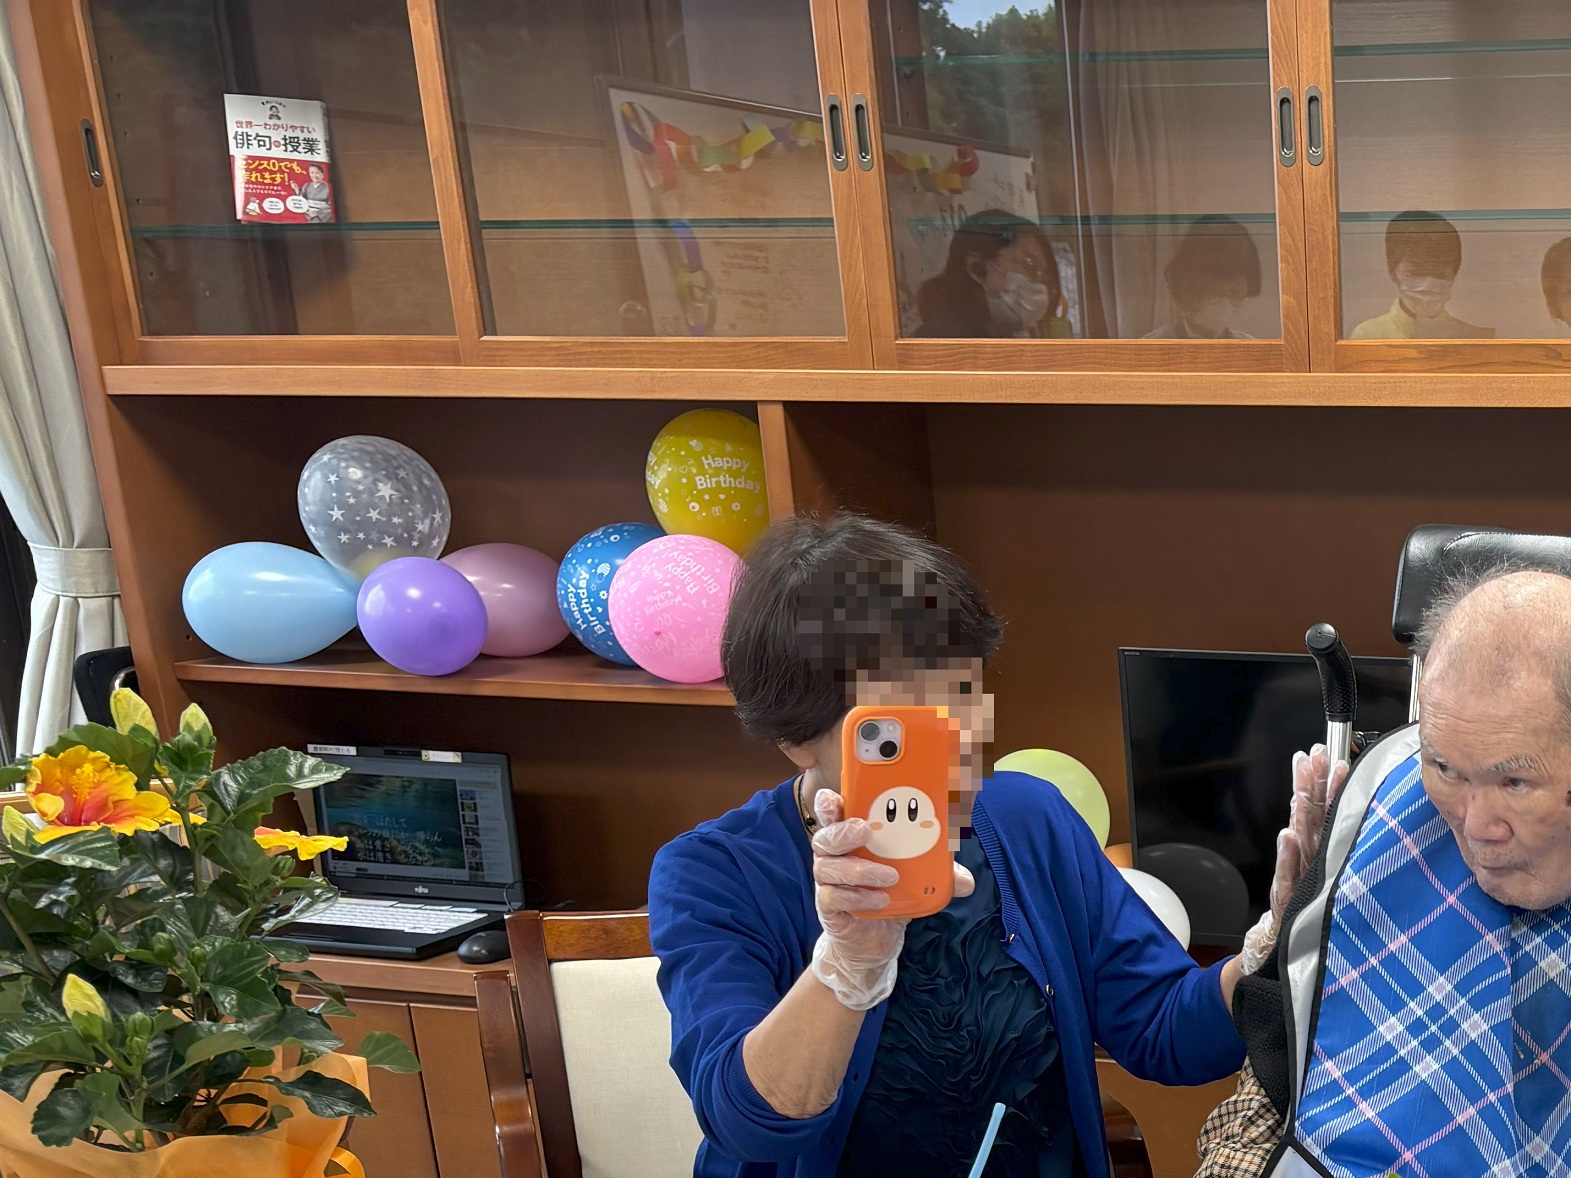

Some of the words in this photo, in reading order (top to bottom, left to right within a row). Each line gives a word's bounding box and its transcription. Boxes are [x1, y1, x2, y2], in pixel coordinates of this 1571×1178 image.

[235, 120, 316, 134] 世界一わかりやすい
[701, 454, 750, 472] Happy
[695, 474, 761, 493] Birthday
[566, 584, 588, 631] Happy
[577, 565, 606, 635] Birthday
